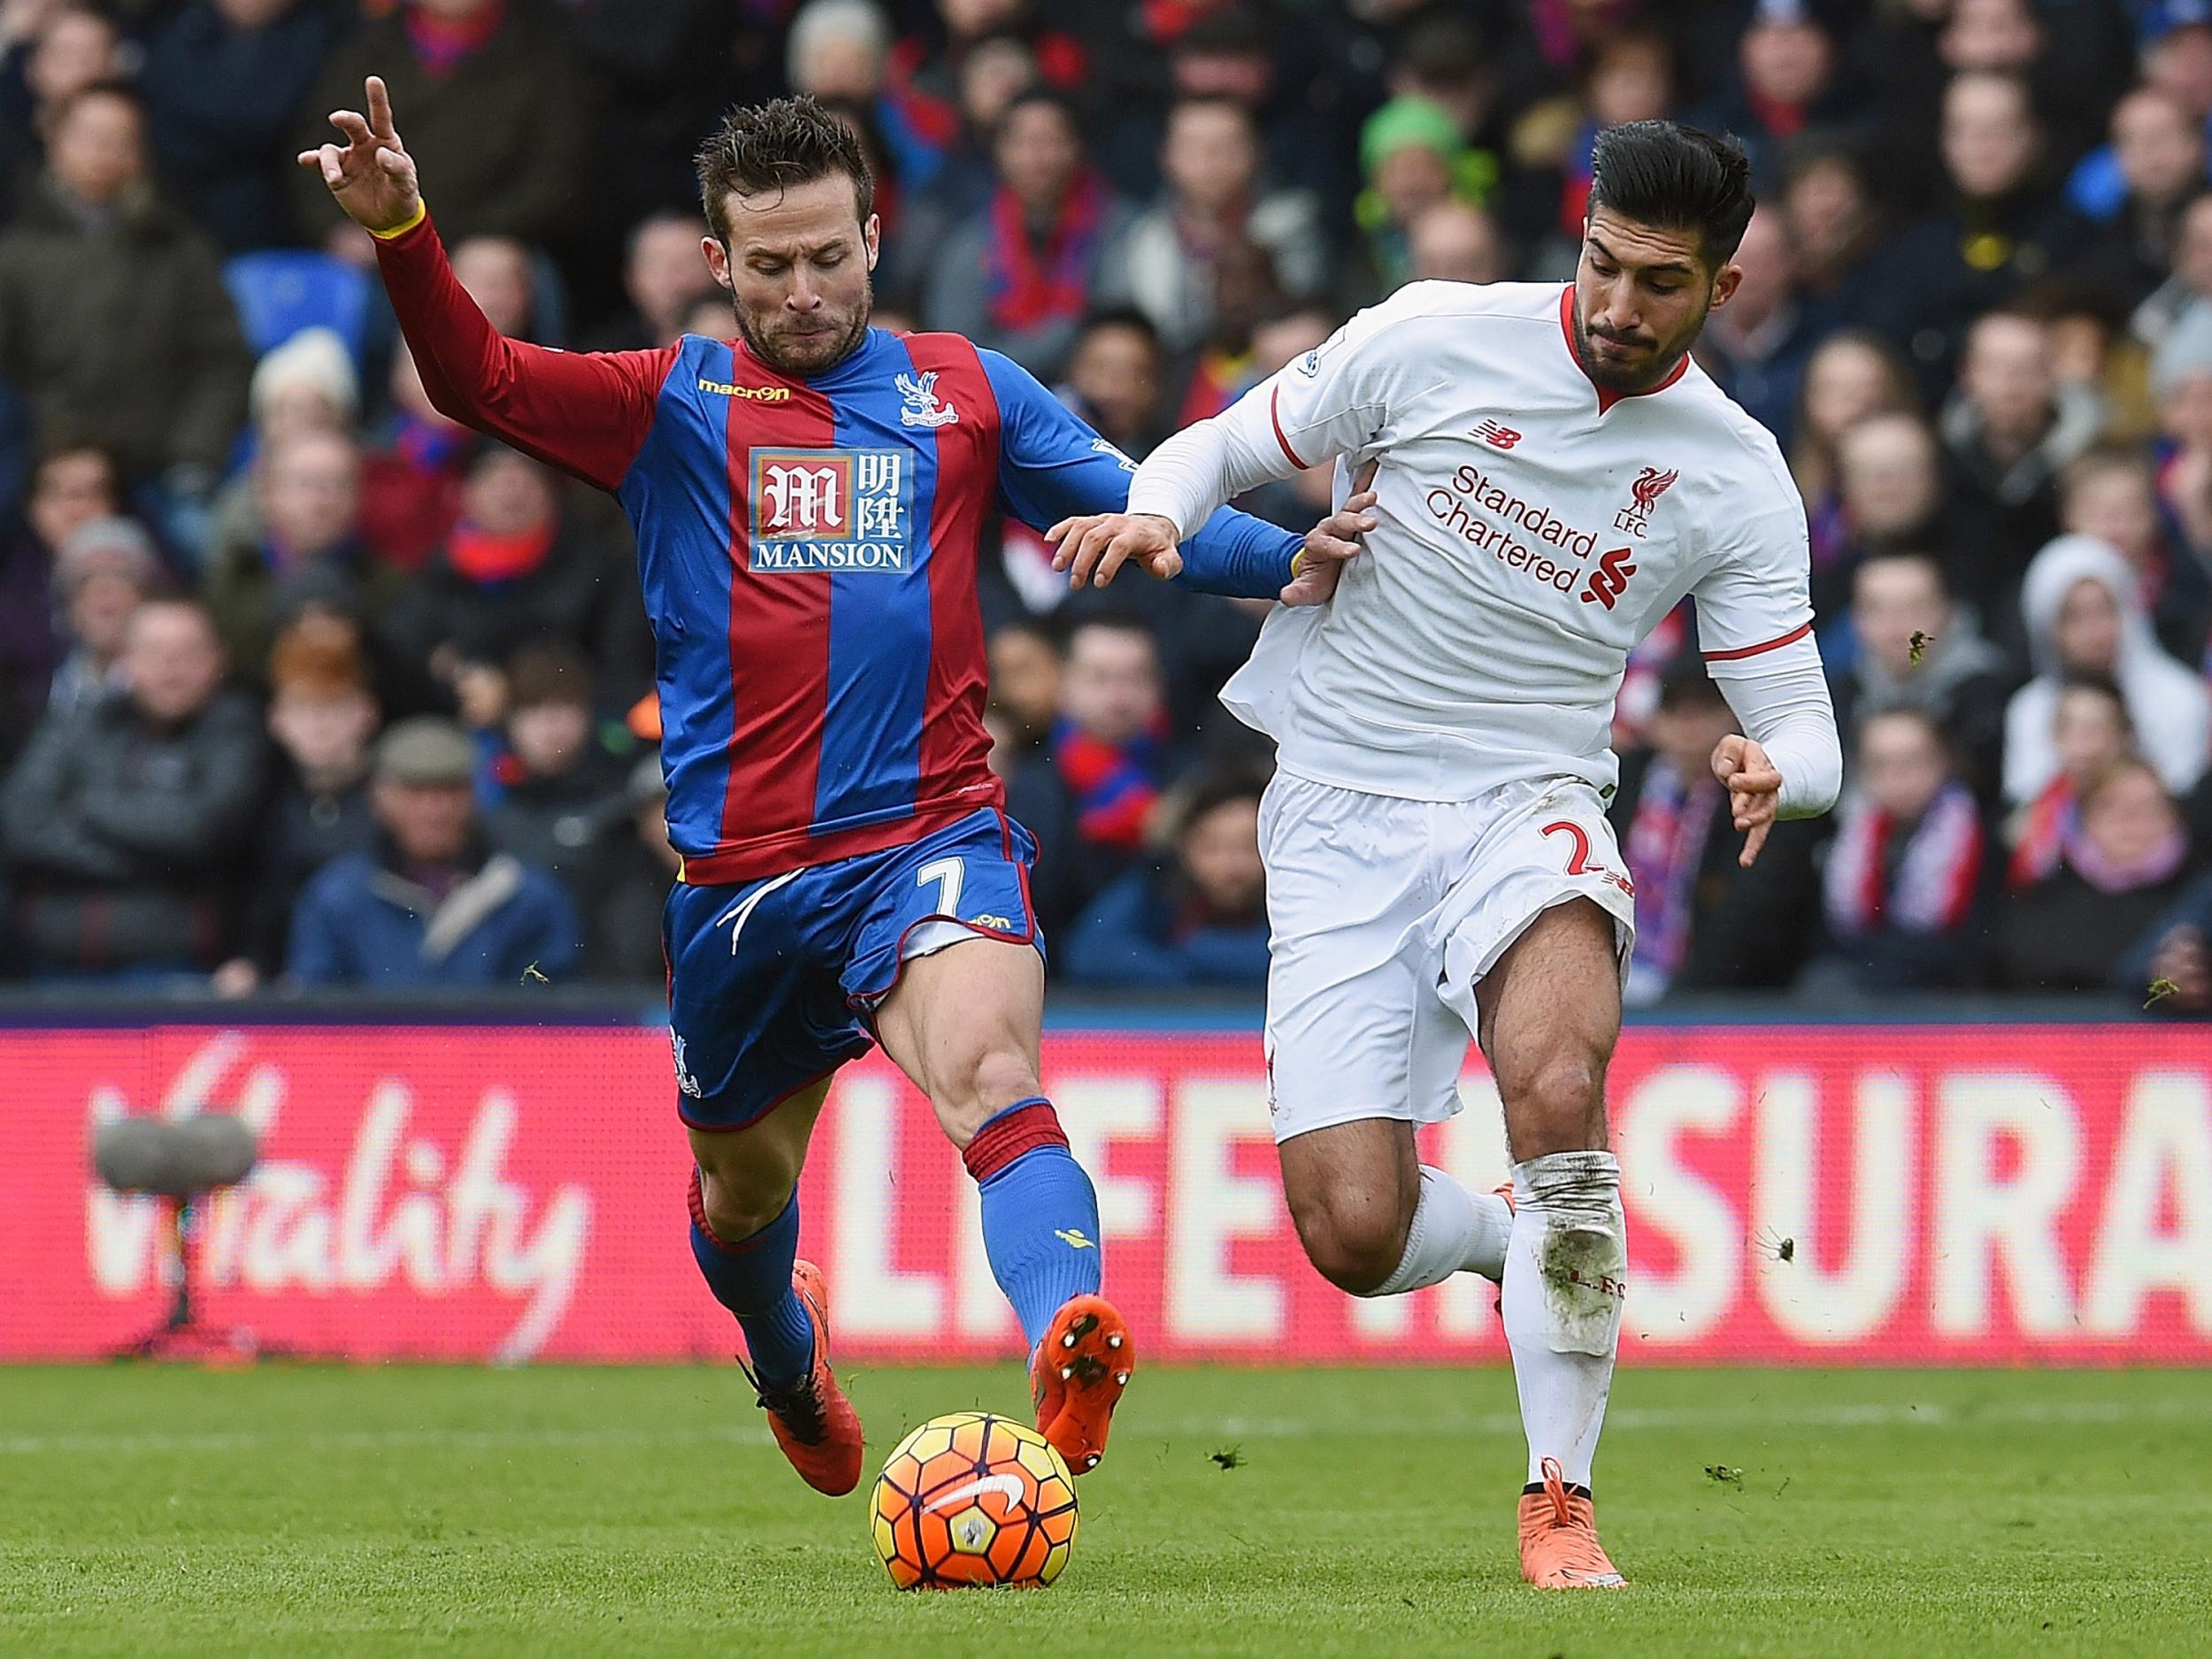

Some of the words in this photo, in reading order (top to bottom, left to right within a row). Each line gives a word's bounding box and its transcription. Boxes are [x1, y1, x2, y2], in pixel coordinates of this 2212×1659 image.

[698, 379, 791, 401] macron
[756, 543, 904, 568] MANSION
[1426, 489, 1581, 594] Chartered
[1452, 465, 1598, 560] Standard
[918, 856, 965, 918] 7
[88, 1028, 593, 1367] Vtality
[1349, 1064, 2212, 1346] SURA
